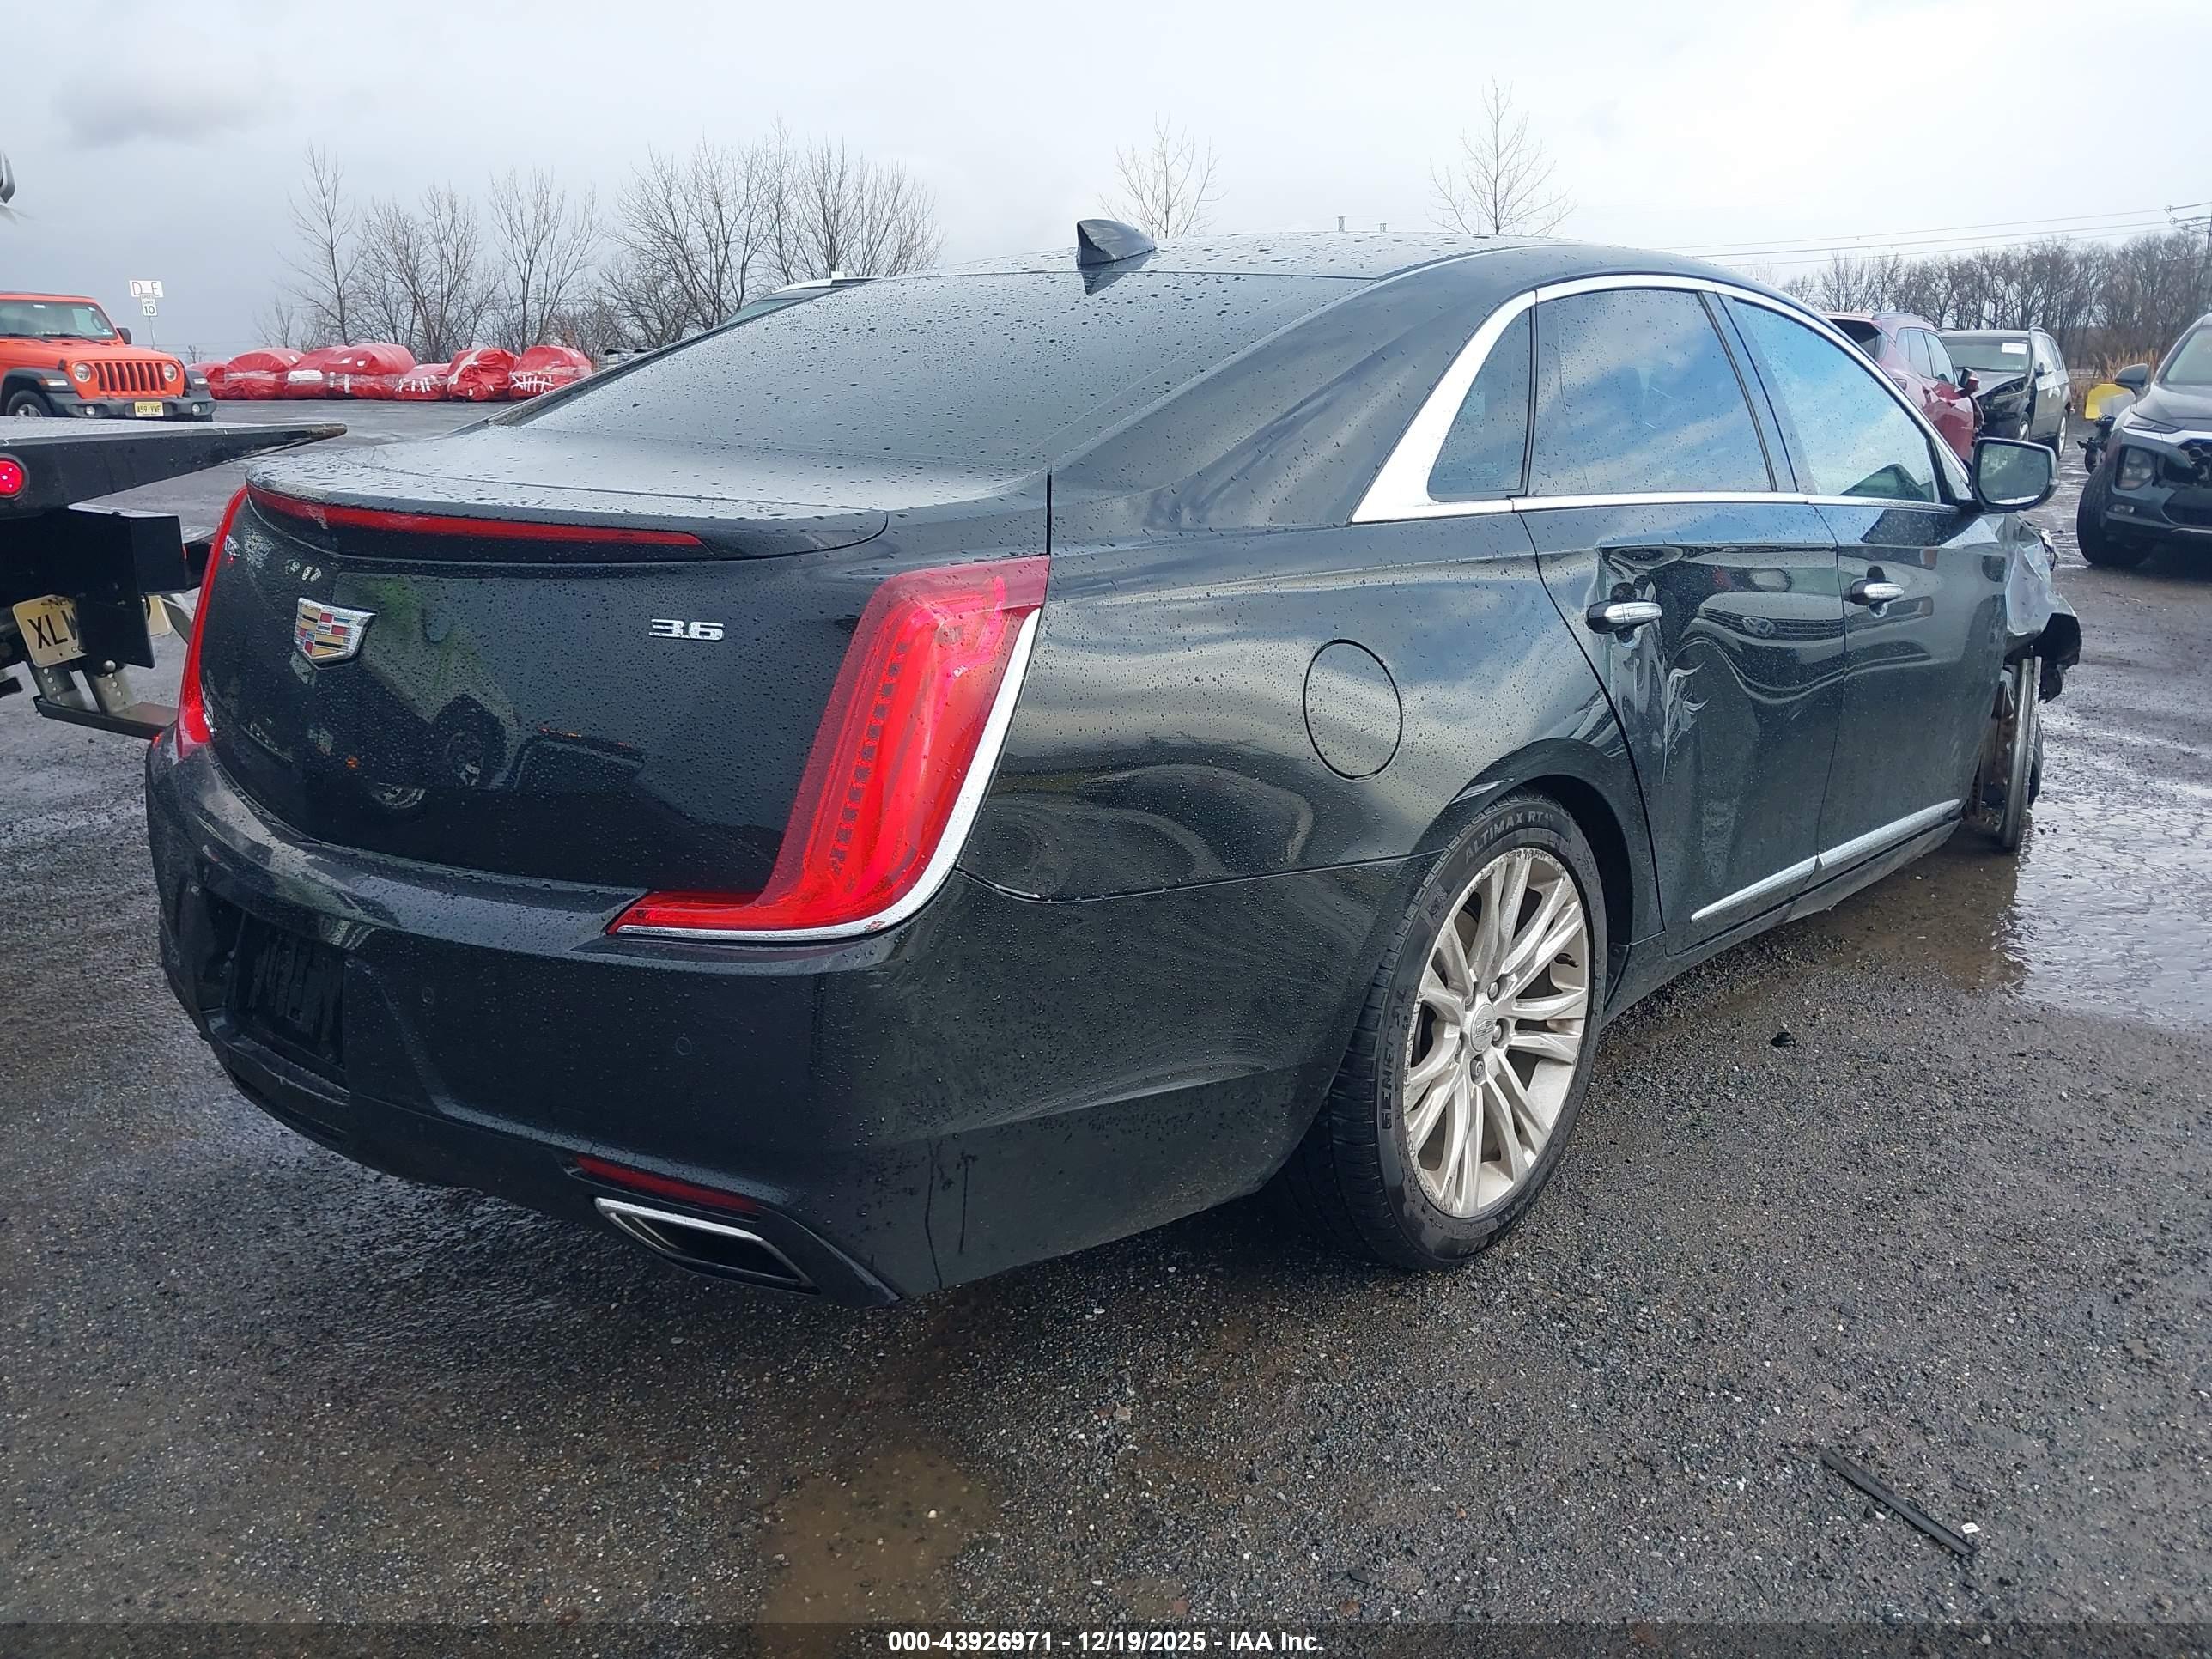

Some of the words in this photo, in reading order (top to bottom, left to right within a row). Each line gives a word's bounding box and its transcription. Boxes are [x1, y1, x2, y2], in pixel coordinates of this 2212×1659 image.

[144, 305, 155, 315] 10
[648, 618, 726, 641] 3.6
[1465, 811, 1523, 865] ALTIMAX
